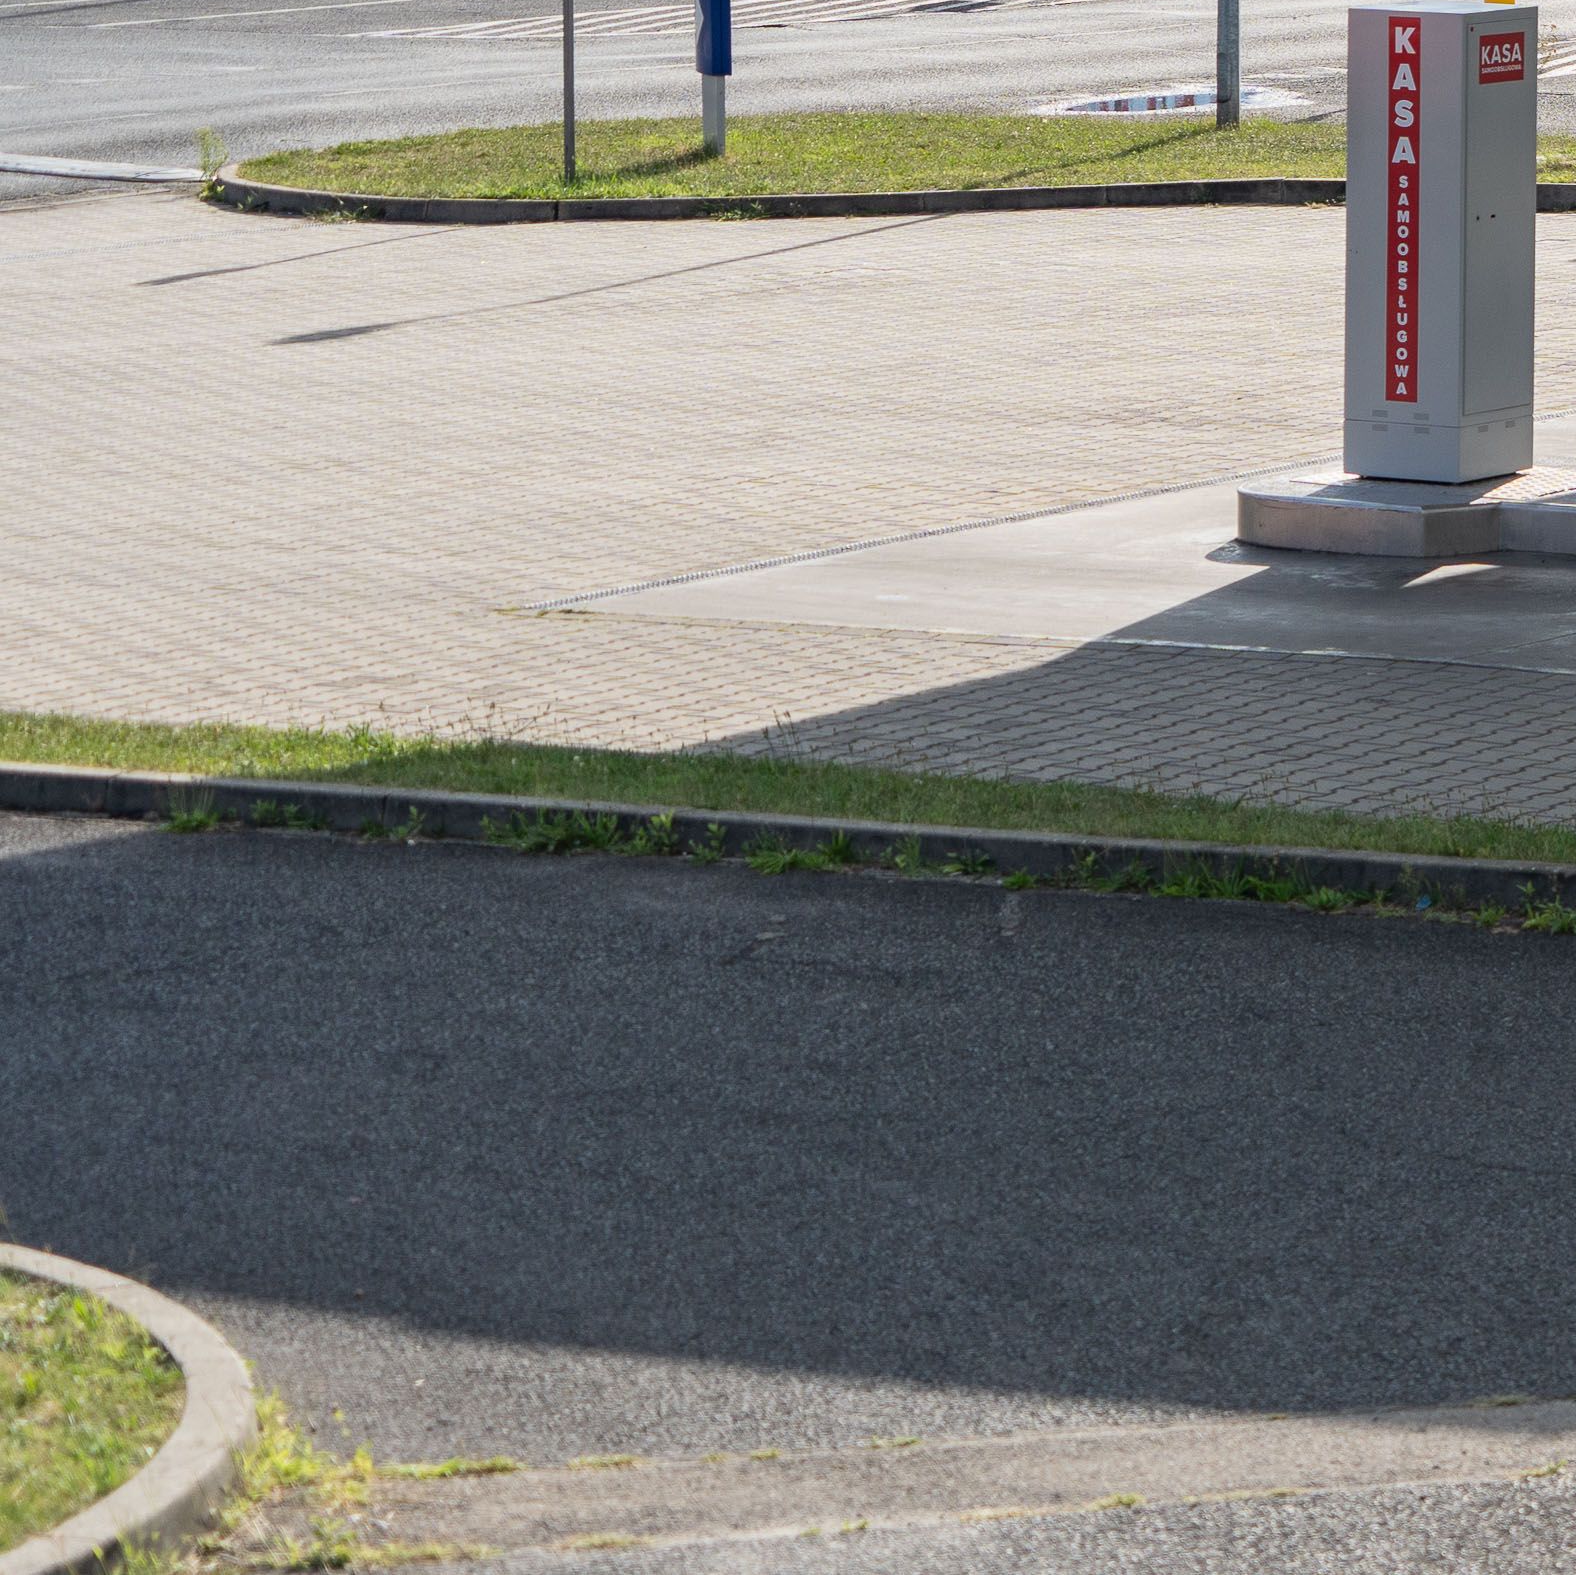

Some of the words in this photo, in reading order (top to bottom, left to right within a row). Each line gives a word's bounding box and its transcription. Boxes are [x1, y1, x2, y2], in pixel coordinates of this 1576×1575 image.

[1391, 26, 1417, 165] KASA
[1481, 42, 1522, 65] KASA
[1394, 175, 1411, 396] SAMOOBSŁUGOWA
